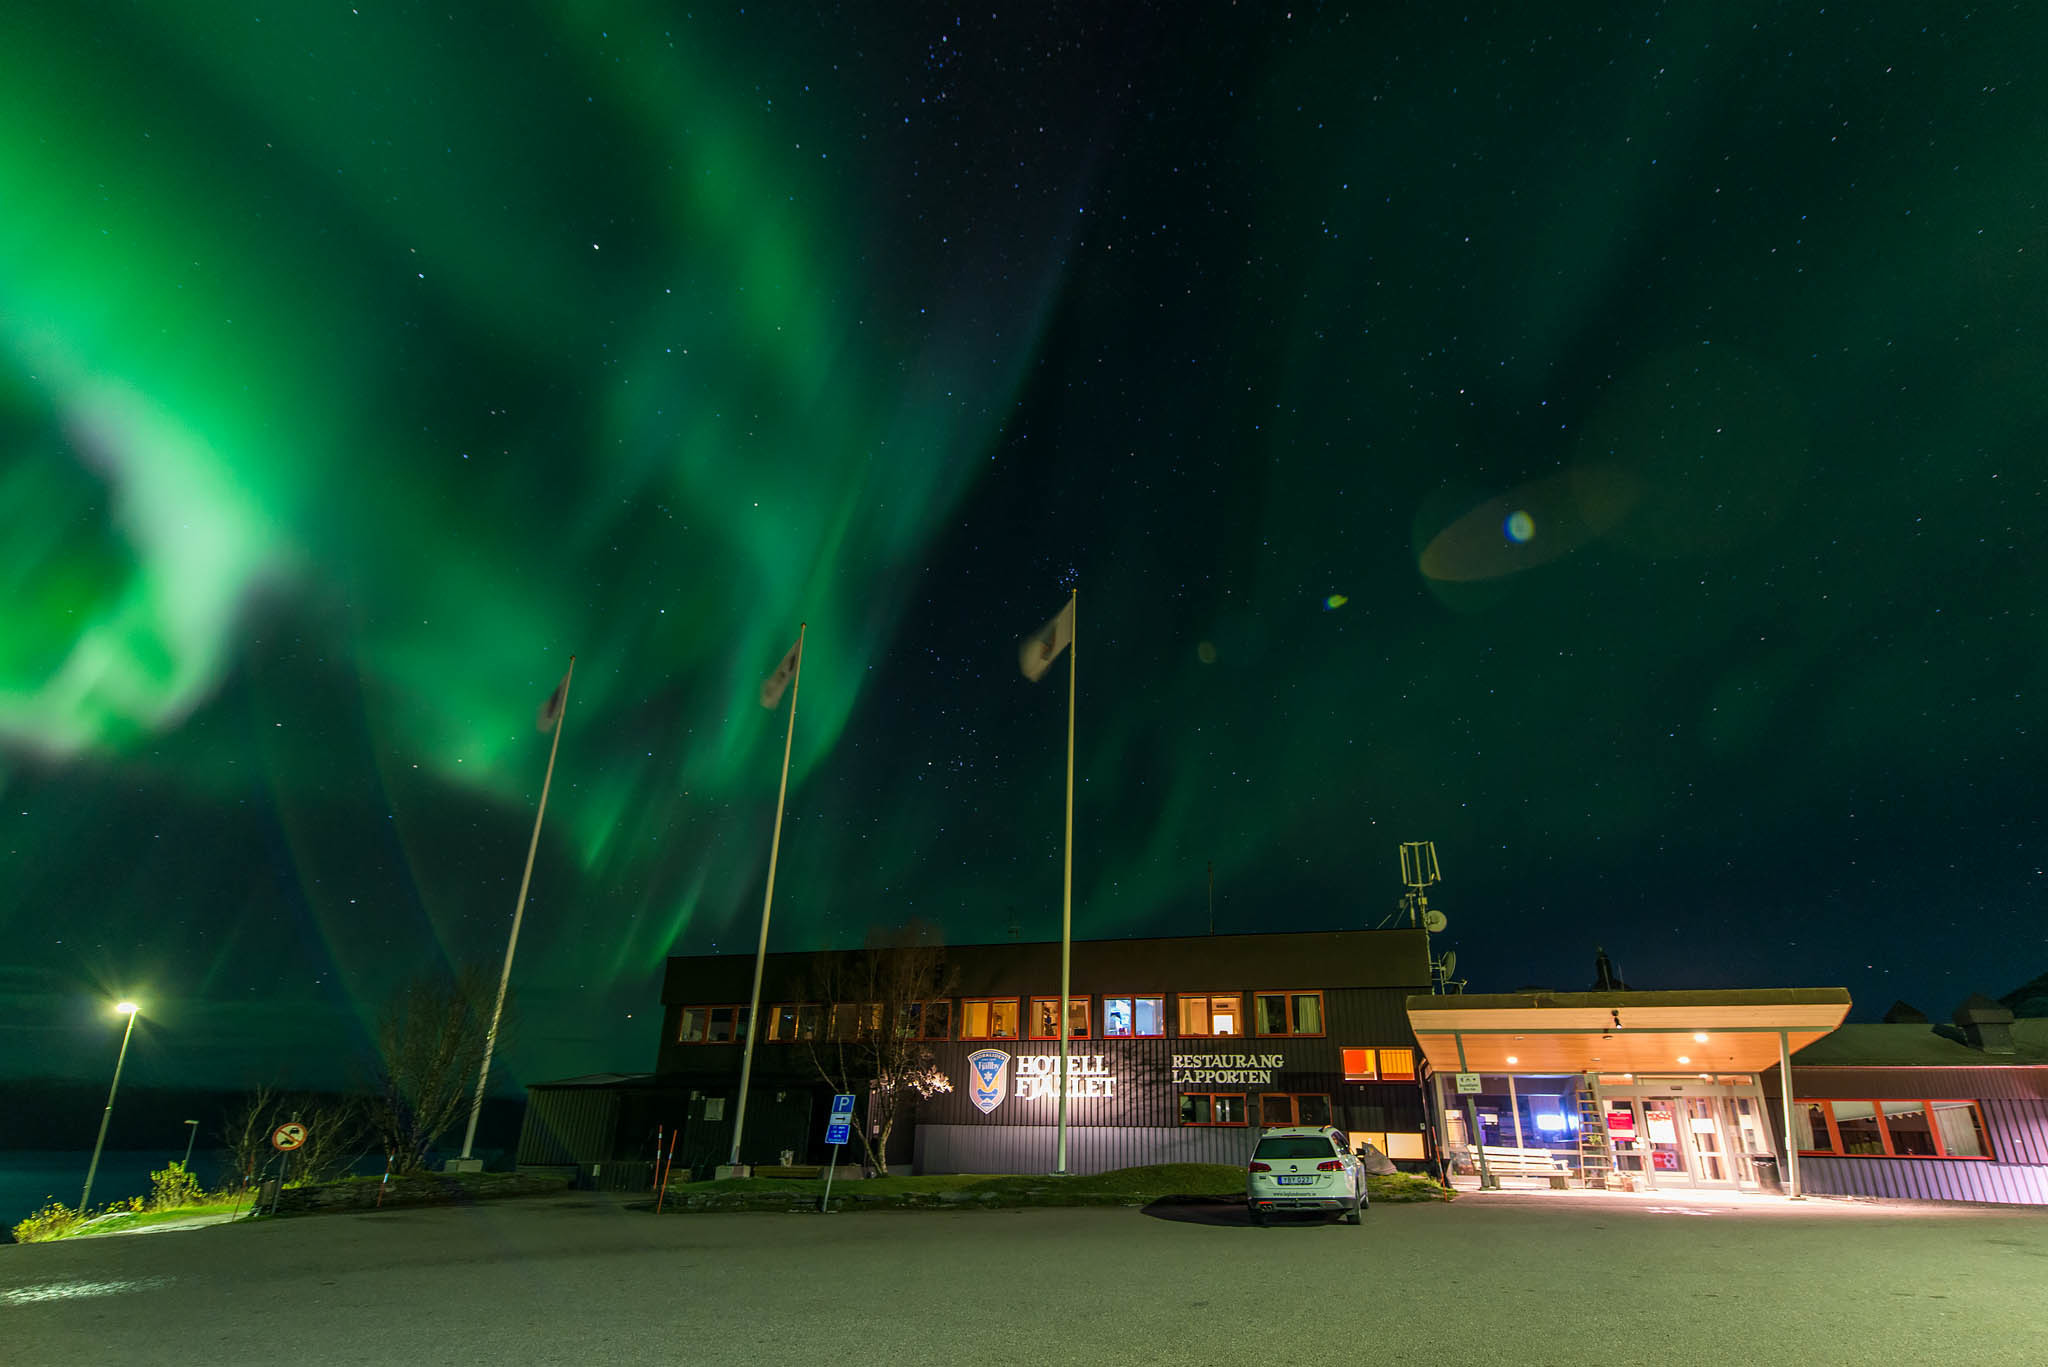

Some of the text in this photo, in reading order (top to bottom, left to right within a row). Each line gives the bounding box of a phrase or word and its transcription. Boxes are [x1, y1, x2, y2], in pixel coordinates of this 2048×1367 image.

[1016, 1055, 1109, 1075] HOTELL
[1171, 1054, 1285, 1068] RESTAURANG
[1171, 1069, 1272, 1084] LAPPORTEN
[838, 1097, 850, 1111] P
